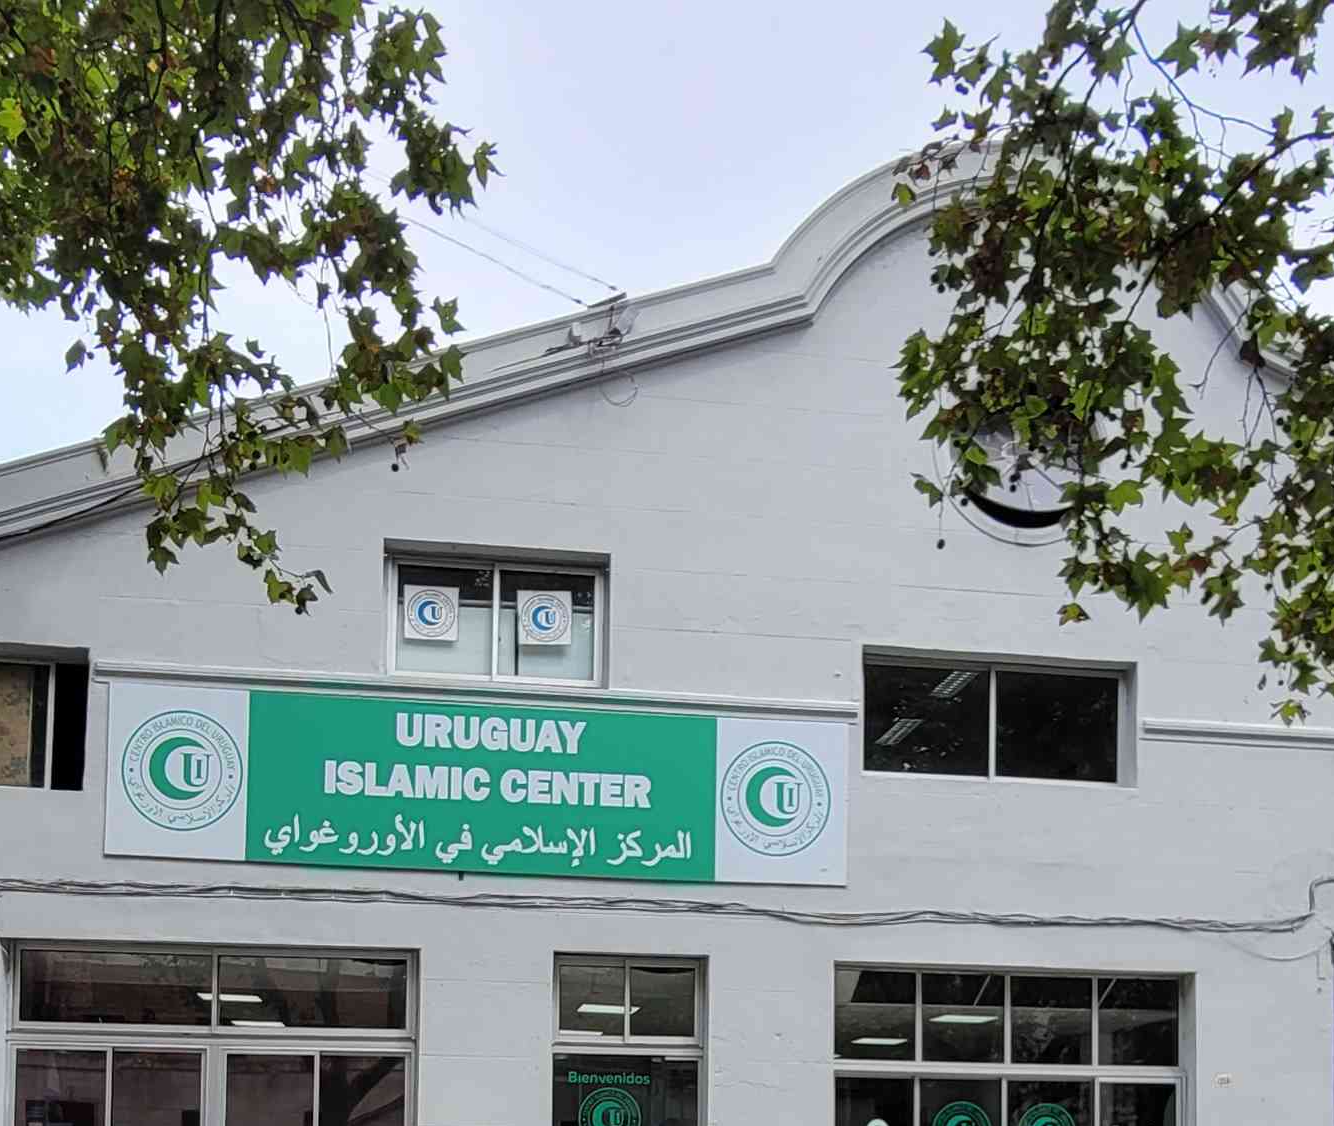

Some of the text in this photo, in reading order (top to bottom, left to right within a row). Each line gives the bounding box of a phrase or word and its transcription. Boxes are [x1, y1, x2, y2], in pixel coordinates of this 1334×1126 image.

[396, 712, 587, 754] URUGUAY
[324, 760, 651, 808] ISLAMIC CENTER
[264, 812, 692, 867] المركز الإسلامي في الأوروغواي
[568, 1071, 651, 1085] Bienvenidos
